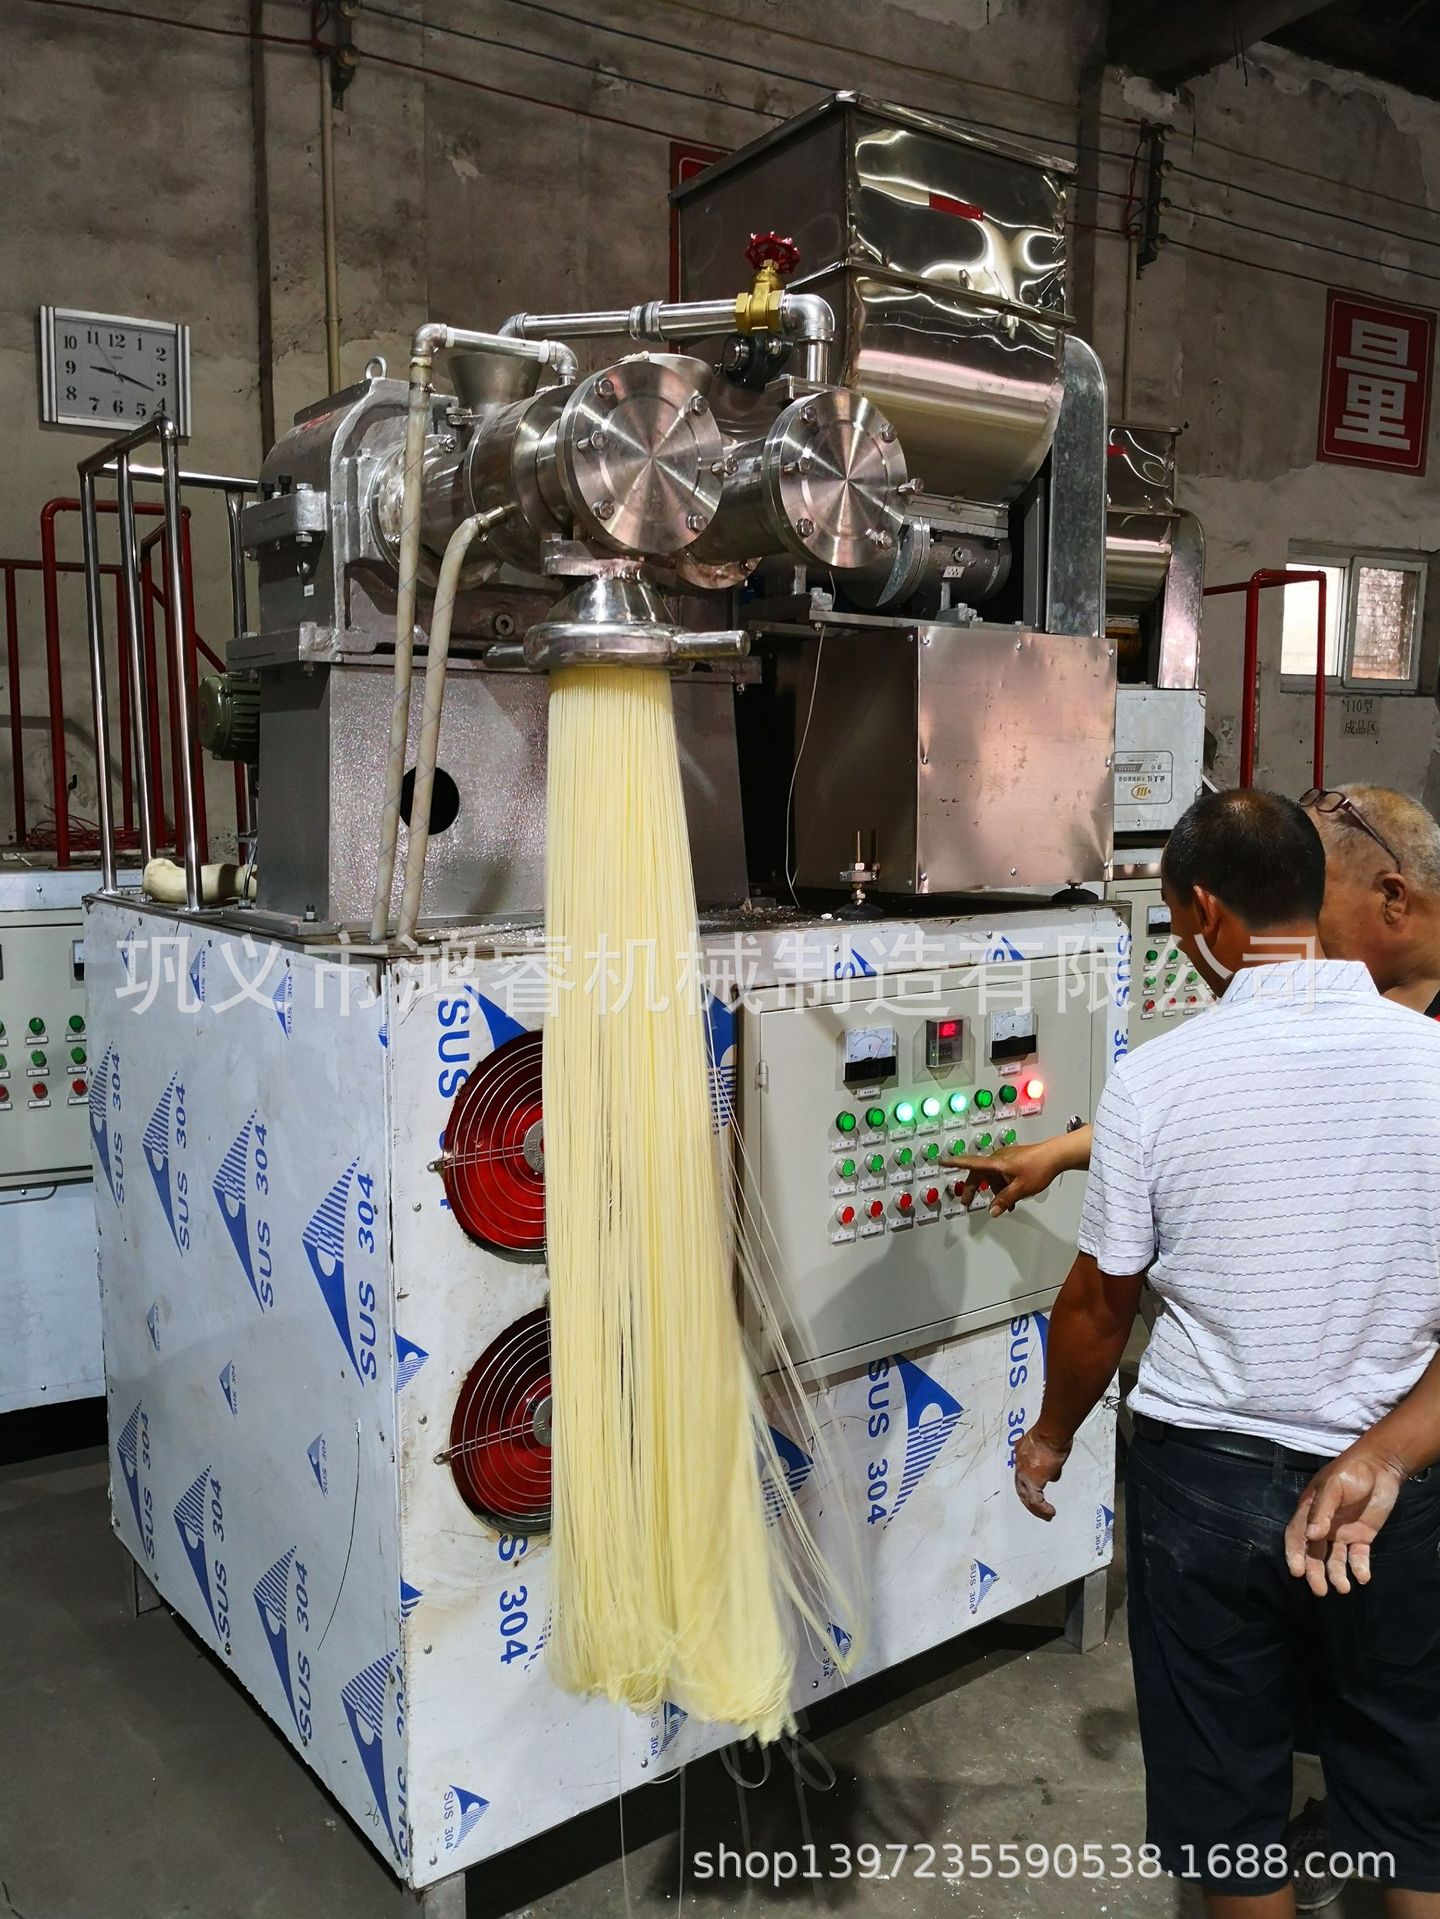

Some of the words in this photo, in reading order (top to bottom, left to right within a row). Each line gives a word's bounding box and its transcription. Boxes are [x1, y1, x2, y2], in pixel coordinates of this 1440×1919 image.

[64, 335, 77, 349] 10
[65, 360, 77, 374] 9
[87, 329, 99, 345] 11
[109, 333, 126, 348] 12
[137, 336, 143, 351] 1
[156, 347, 167, 362] 2
[66, 386, 77, 400] 8
[89, 397, 100, 413] 7
[112, 400, 123, 414] 6
[136, 402, 147, 417] 5
[156, 373, 167, 387] 3
[1334, 318, 1418, 451] 量
[112, 1052, 121, 1111] 304
[176, 1083, 187, 1150] 304
[114, 1131, 125, 1204] SUS
[256, 1123, 268, 1196] 304
[179, 1171, 191, 1251] SUS
[358, 1173, 374, 1254] 304
[260, 1219, 273, 1308] SUS
[359, 1282, 377, 1380] SUS
[1009, 1315, 1029, 1388] SUS
[868, 1358, 890, 1438] SUS
[141, 1412, 150, 1470] 304
[144, 1487, 155, 1560] SUS
[211, 1478, 224, 1543] 304
[867, 1458, 888, 1525] 304
[214, 1560, 230, 1652] SUS
[293, 1560, 307, 1633] 304
[499, 1585, 528, 1665] 304
[296, 1652, 313, 1742] SUS
[650, 1735, 659, 1756] 304
[444, 1791, 454, 1821] SUS
[444, 1826, 454, 1850] 304
